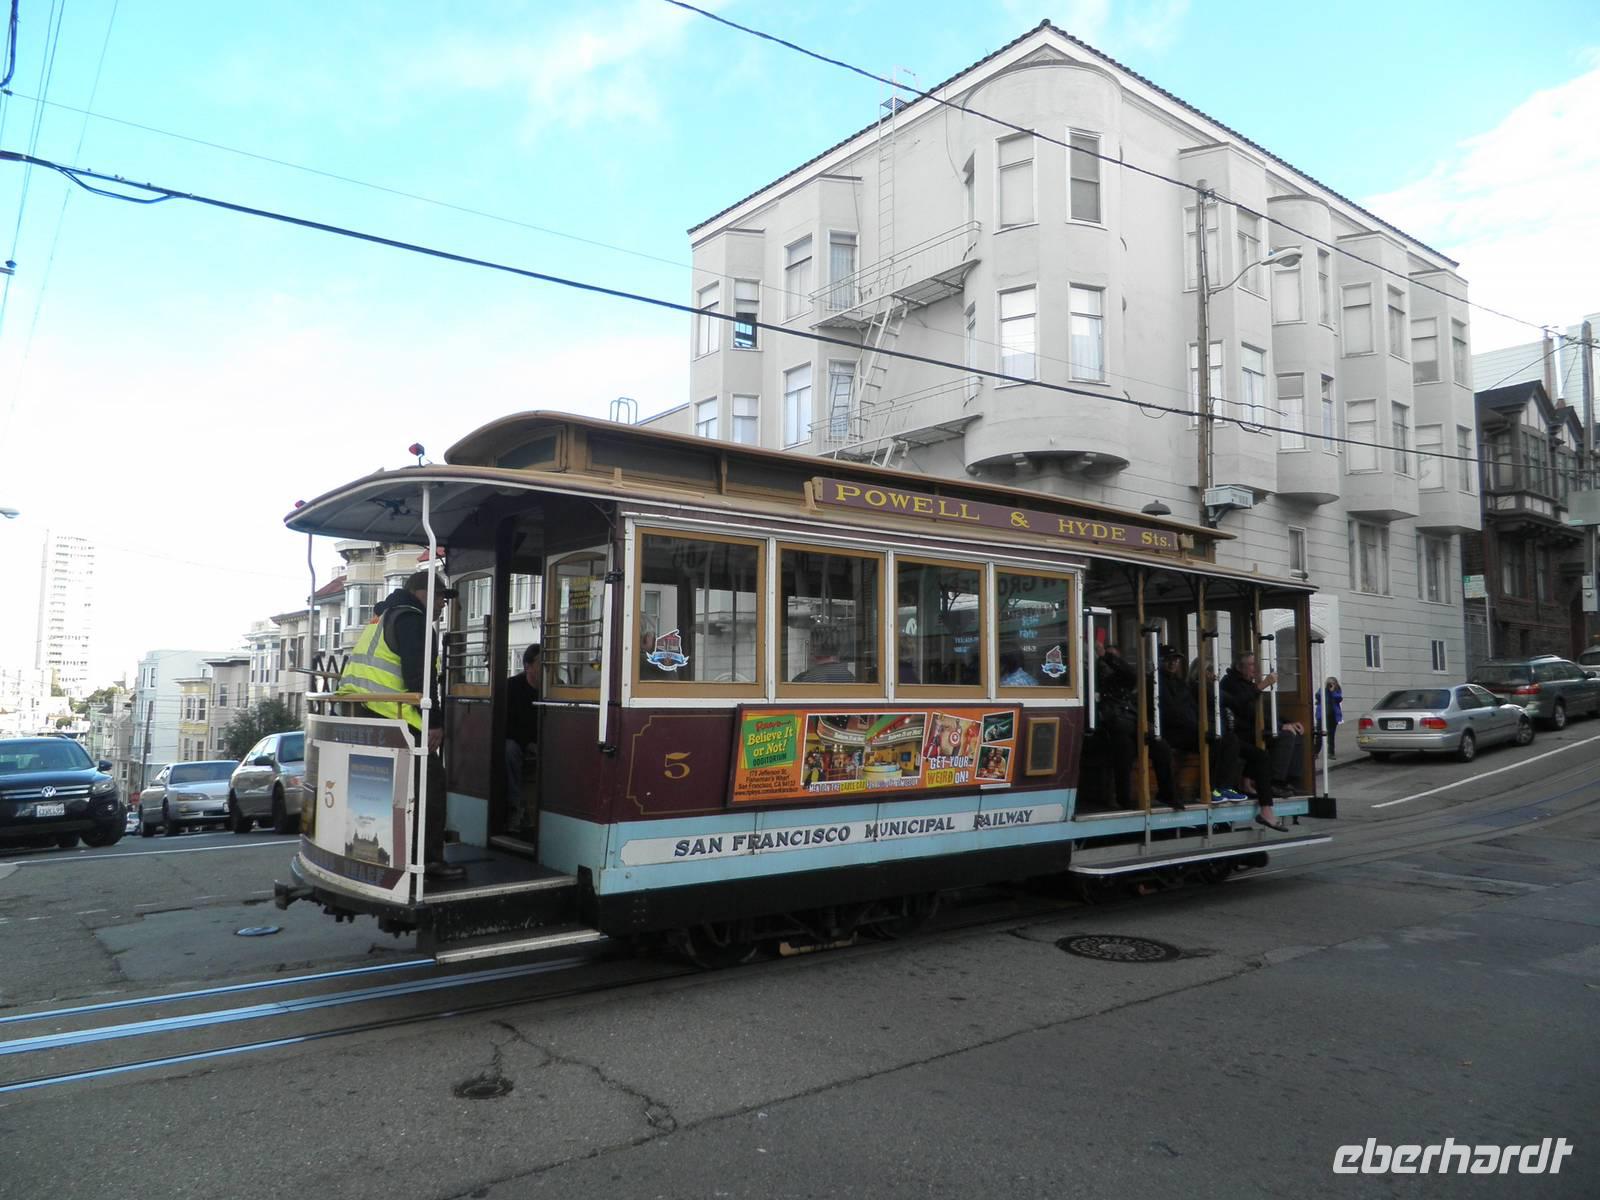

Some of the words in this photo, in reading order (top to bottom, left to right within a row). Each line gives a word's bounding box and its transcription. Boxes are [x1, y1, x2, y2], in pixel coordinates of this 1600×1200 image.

[835, 483, 980, 521] POWELL
[1010, 510, 1030, 529] &
[1058, 518, 1126, 541] HYDE
[1141, 531, 1171, 547] Sts.
[747, 730, 782, 746] Believe
[785, 727, 793, 738] It
[753, 746, 765, 757] or
[765, 740, 786, 755] Not!
[663, 752, 692, 780] 5
[930, 755, 947, 769] GET
[928, 769, 953, 785] WEIRD
[955, 770, 969, 784] ON!
[324, 780, 336, 809] 5
[674, 839, 722, 857] SAN
[732, 825, 851, 852] FRANCISCO
[864, 816, 956, 839] MUNICIPAL
[973, 809, 1033, 830] RAILWAY
